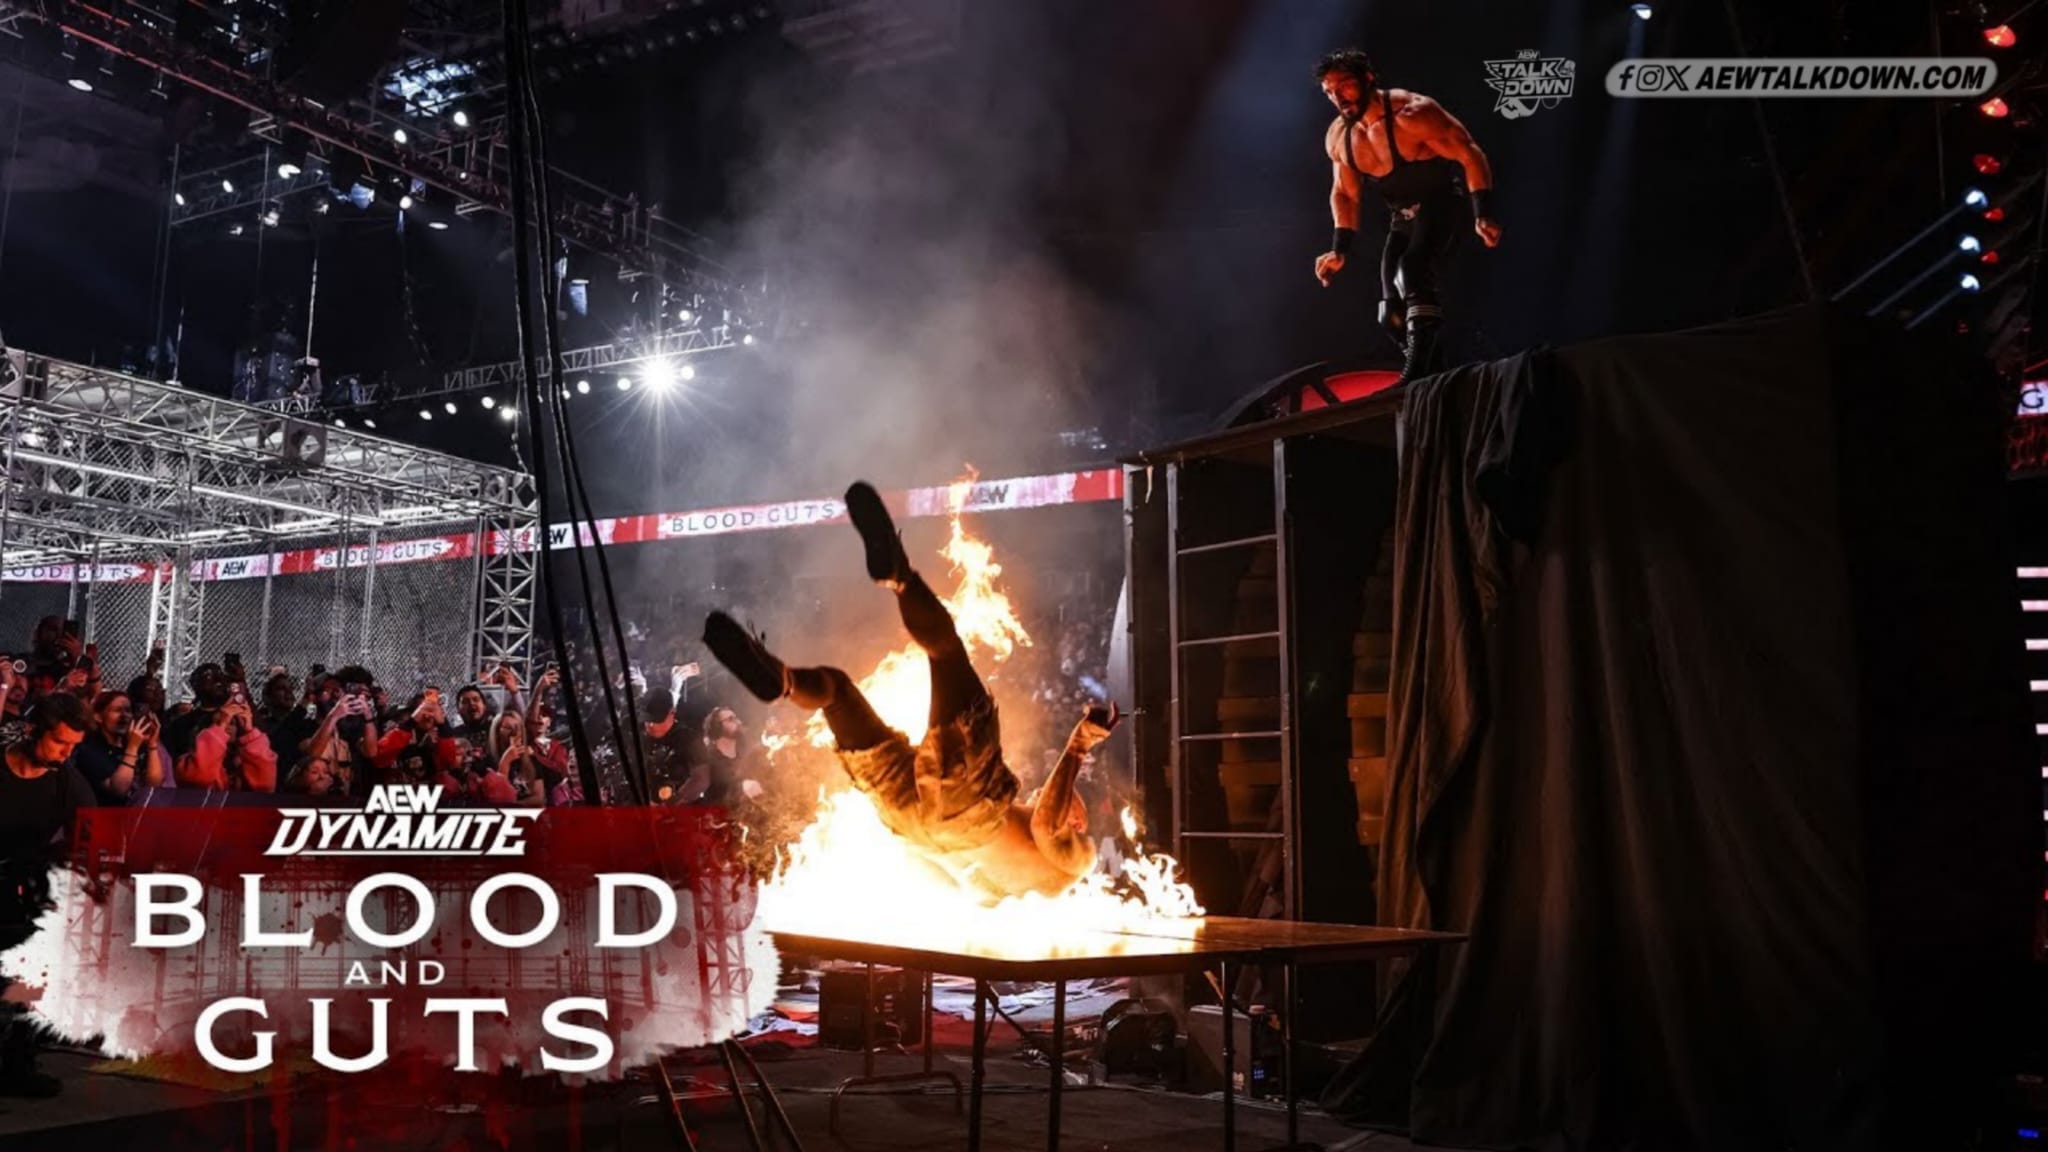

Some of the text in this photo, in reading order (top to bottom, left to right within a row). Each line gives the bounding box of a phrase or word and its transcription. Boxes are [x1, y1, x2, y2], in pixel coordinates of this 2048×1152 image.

[671, 511, 755, 532] BLOOD
[767, 503, 834, 523] GUTS
[393, 541, 443, 560] GUTS
